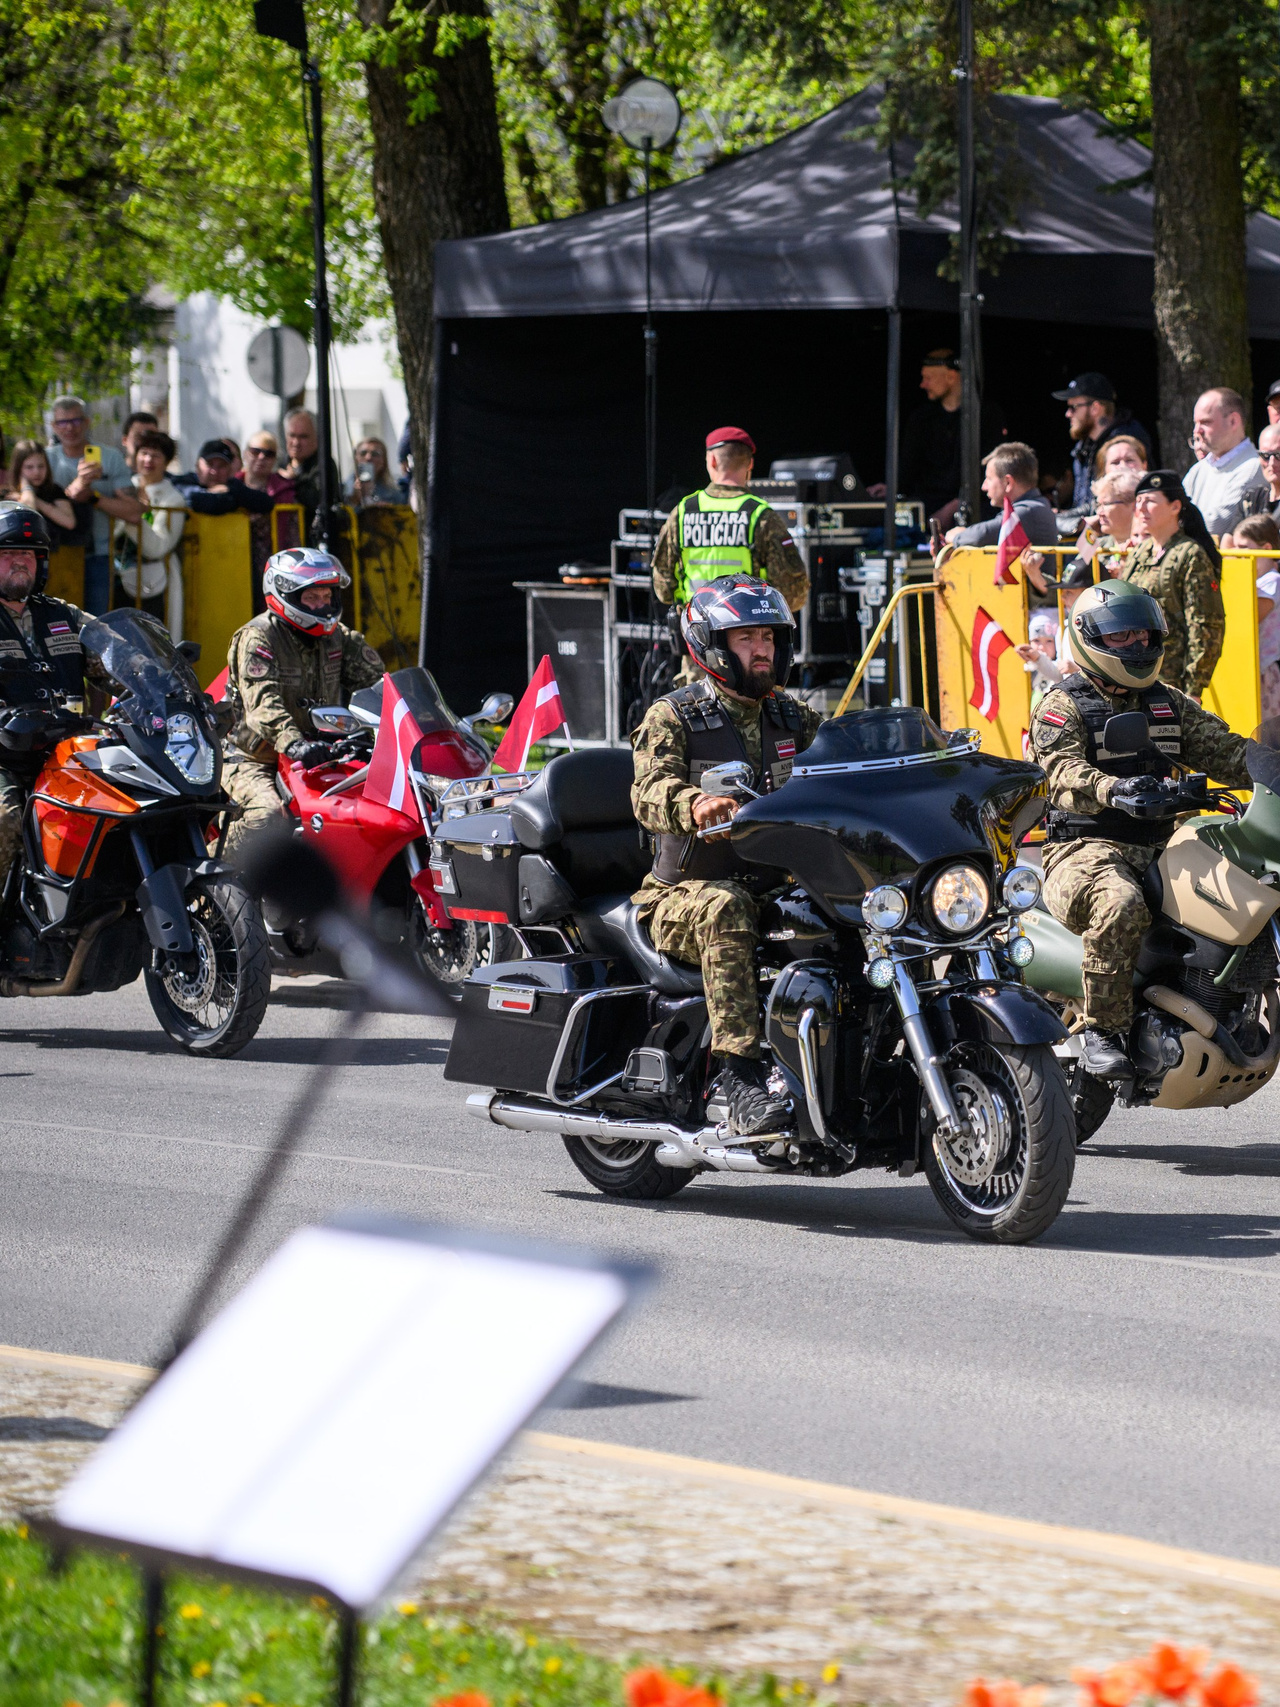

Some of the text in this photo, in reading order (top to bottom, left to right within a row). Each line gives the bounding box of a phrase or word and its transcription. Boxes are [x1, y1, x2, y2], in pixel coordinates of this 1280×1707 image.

[684, 511, 748, 525] MILITĀRĀ
[684, 524, 748, 547] POLICIJA
[936, 1179, 970, 1218] MICHELIN
